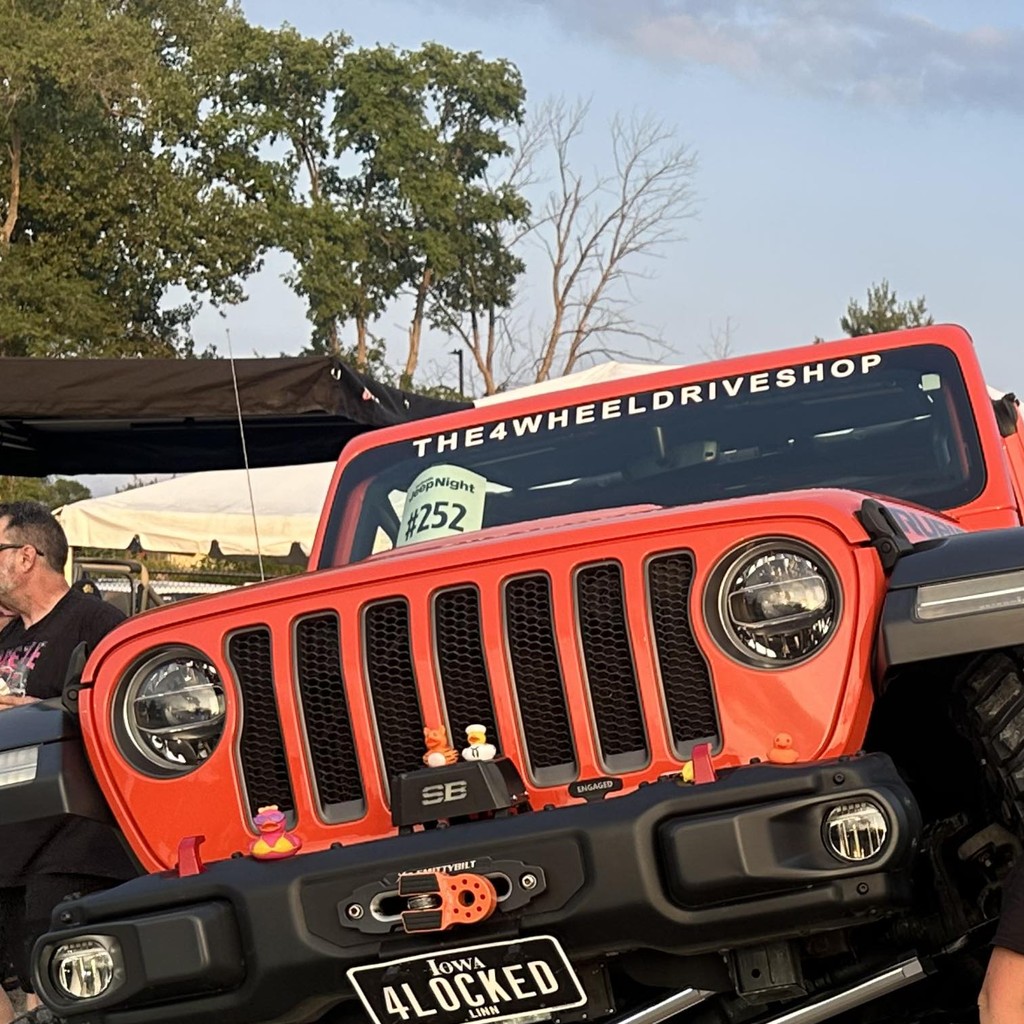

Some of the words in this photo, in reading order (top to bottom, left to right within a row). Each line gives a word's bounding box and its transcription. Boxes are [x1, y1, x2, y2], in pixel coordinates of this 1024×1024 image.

[413, 354, 883, 458] THE4WHEELDRIVESHOP
[405, 501, 467, 541] #252
[576, 780, 614, 793] ENGAGED
[382, 960, 559, 1020] 4LOCKED
[469, 1005, 500, 1019] LINN
